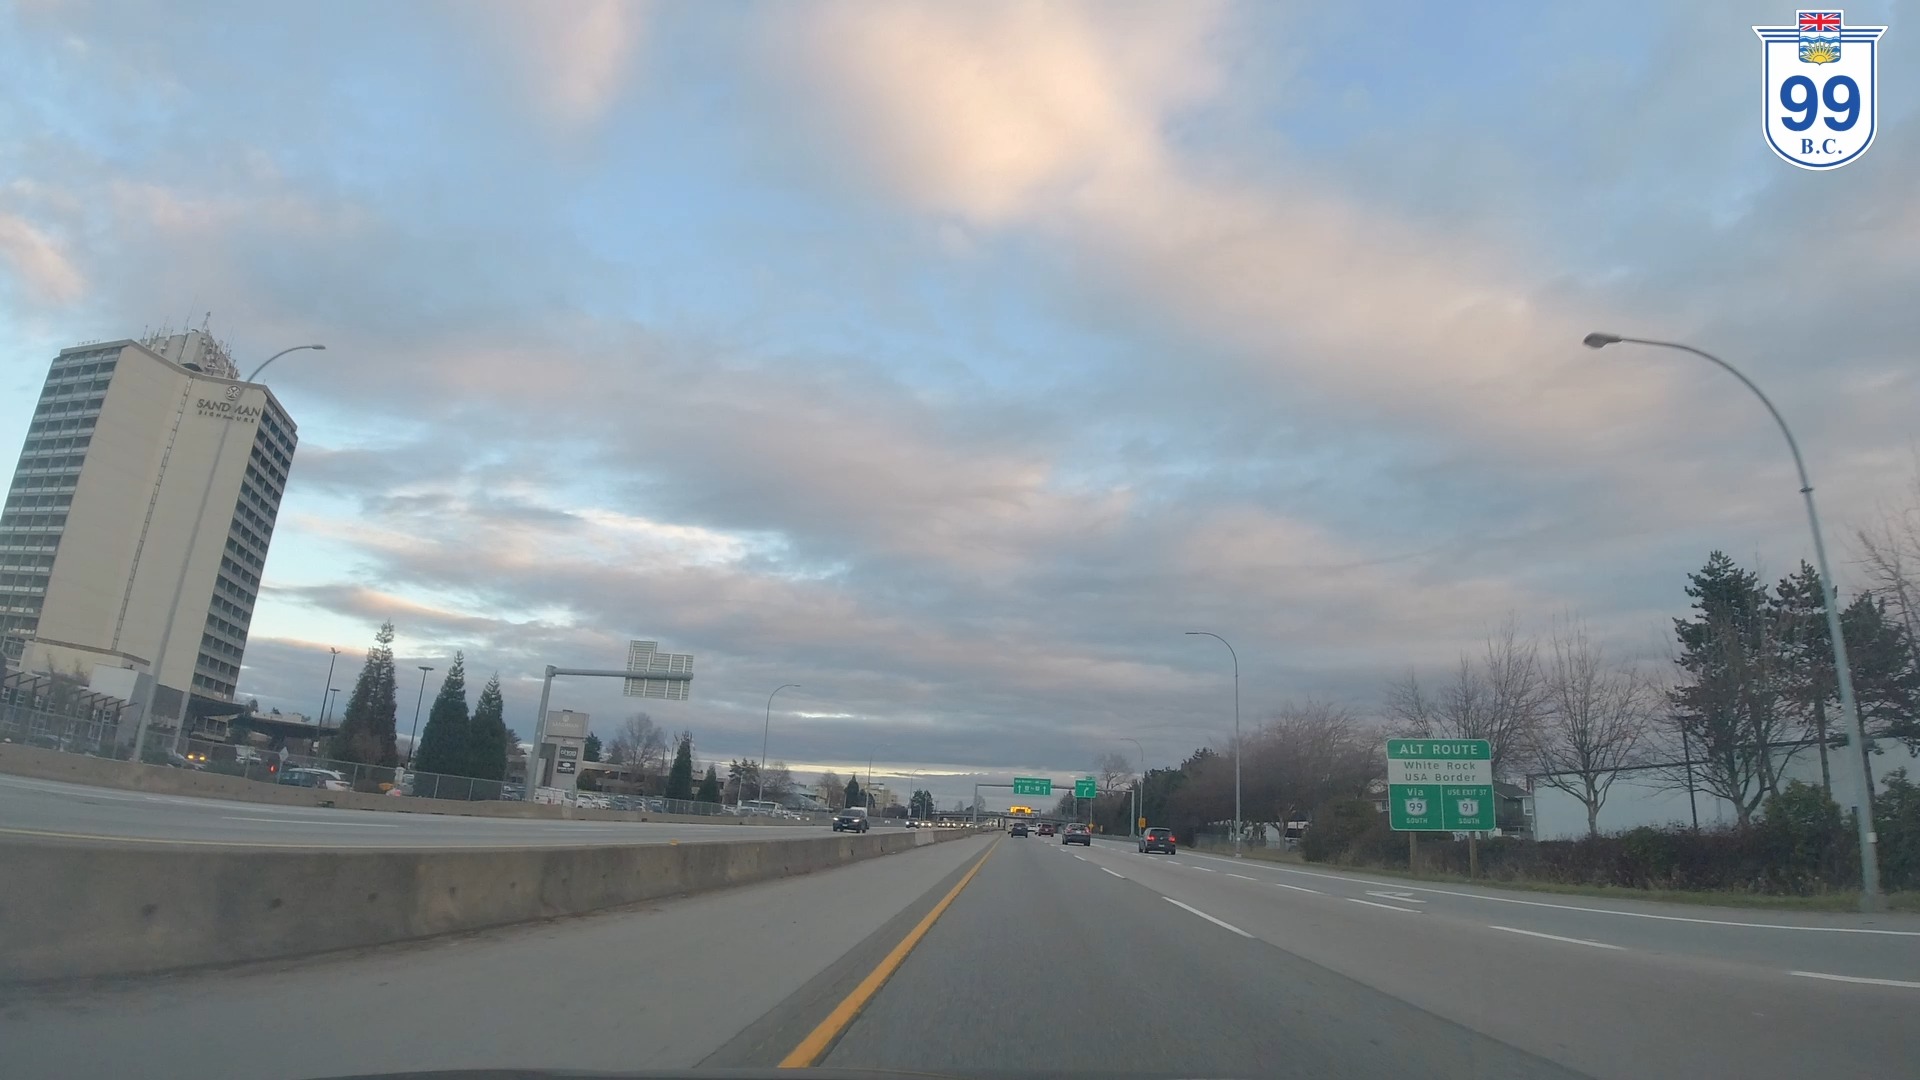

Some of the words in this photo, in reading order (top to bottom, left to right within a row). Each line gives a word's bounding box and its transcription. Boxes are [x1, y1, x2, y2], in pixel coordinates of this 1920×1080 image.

[1399, 744, 1424, 755] ALT
[1433, 744, 1478, 755] ROUTE
[1403, 761, 1440, 770] White
[1447, 761, 1476, 770] Rock
[1405, 773, 1428, 781] USA
[1435, 773, 1477, 782] Border
[1407, 788, 1424, 796] Via
[1409, 802, 1423, 812] 99
[1462, 802, 1474, 812] 91
[1458, 817, 1480, 825] SOUTH
